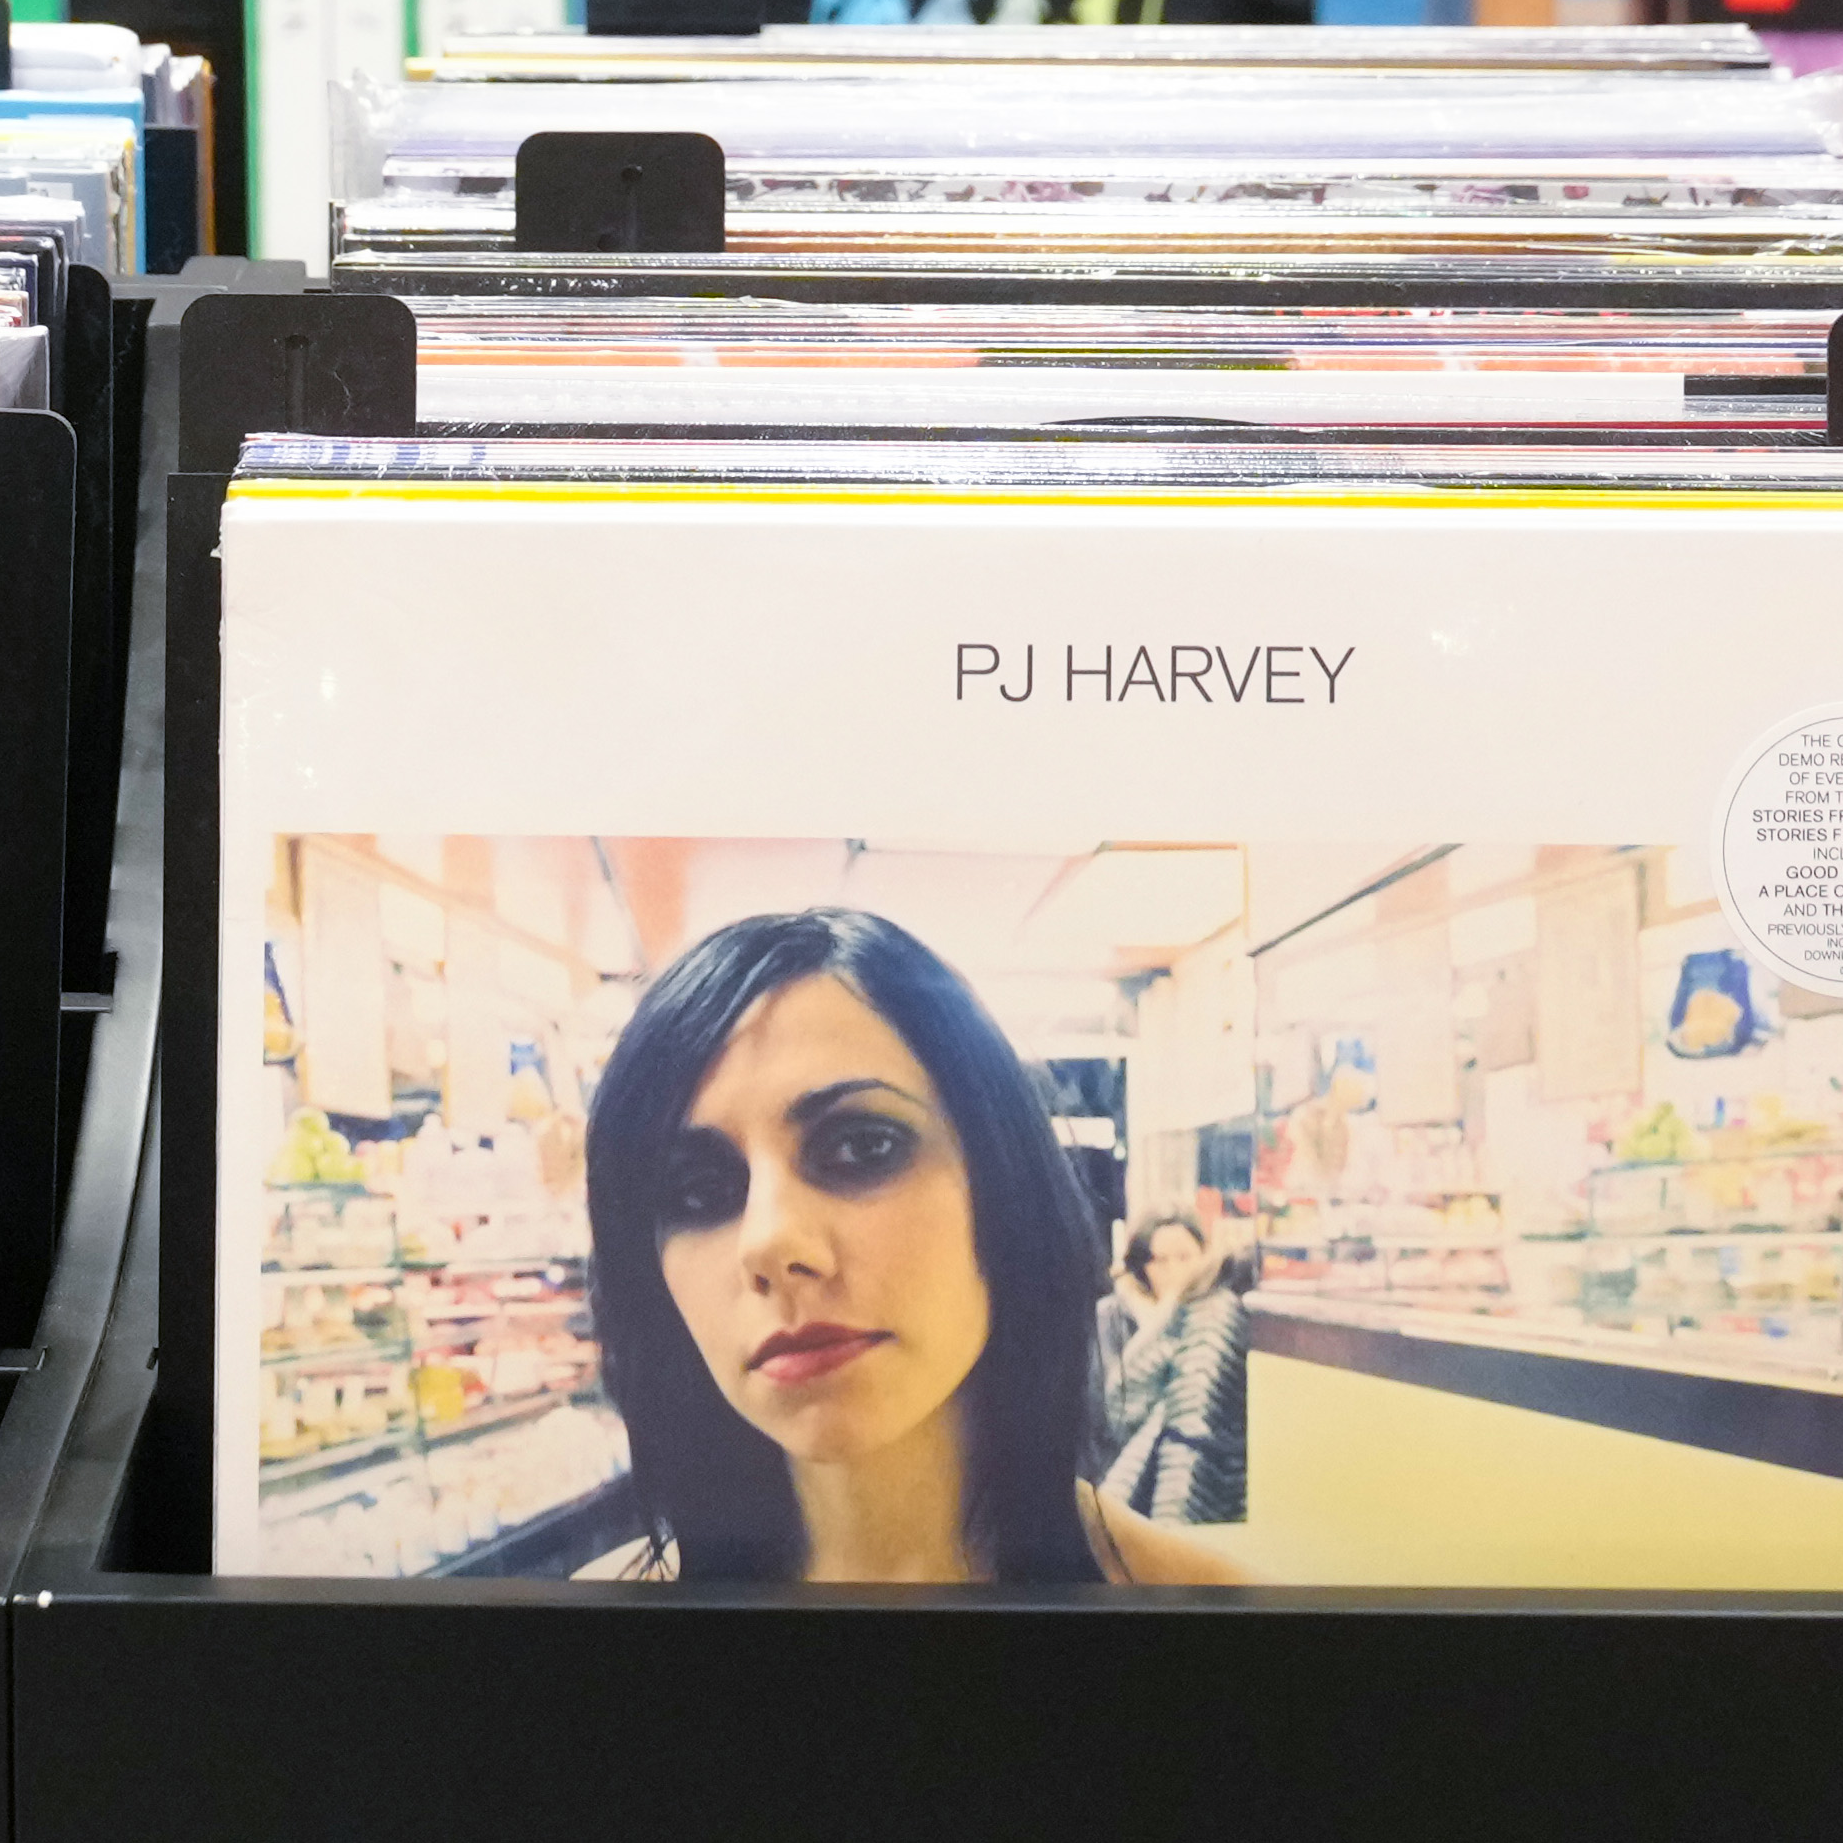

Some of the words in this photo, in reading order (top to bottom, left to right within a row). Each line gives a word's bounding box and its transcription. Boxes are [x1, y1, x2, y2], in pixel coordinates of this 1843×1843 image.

[956, 643, 1034, 702] PJ
[1066, 644, 1356, 704] HARVEY
[1800, 734, 1832, 747] THE
[1778, 753, 1825, 766] DEMO
[1789, 771, 1810, 785] OF
[1785, 790, 1830, 804] FROM
[1752, 809, 1824, 823] STORIES
[1756, 828, 1828, 841] STORIES
[1785, 865, 1839, 879] GOOD
[1758, 884, 1769, 898] A
[1774, 884, 1829, 898] PLACE
[1783, 903, 1818, 917] AND
